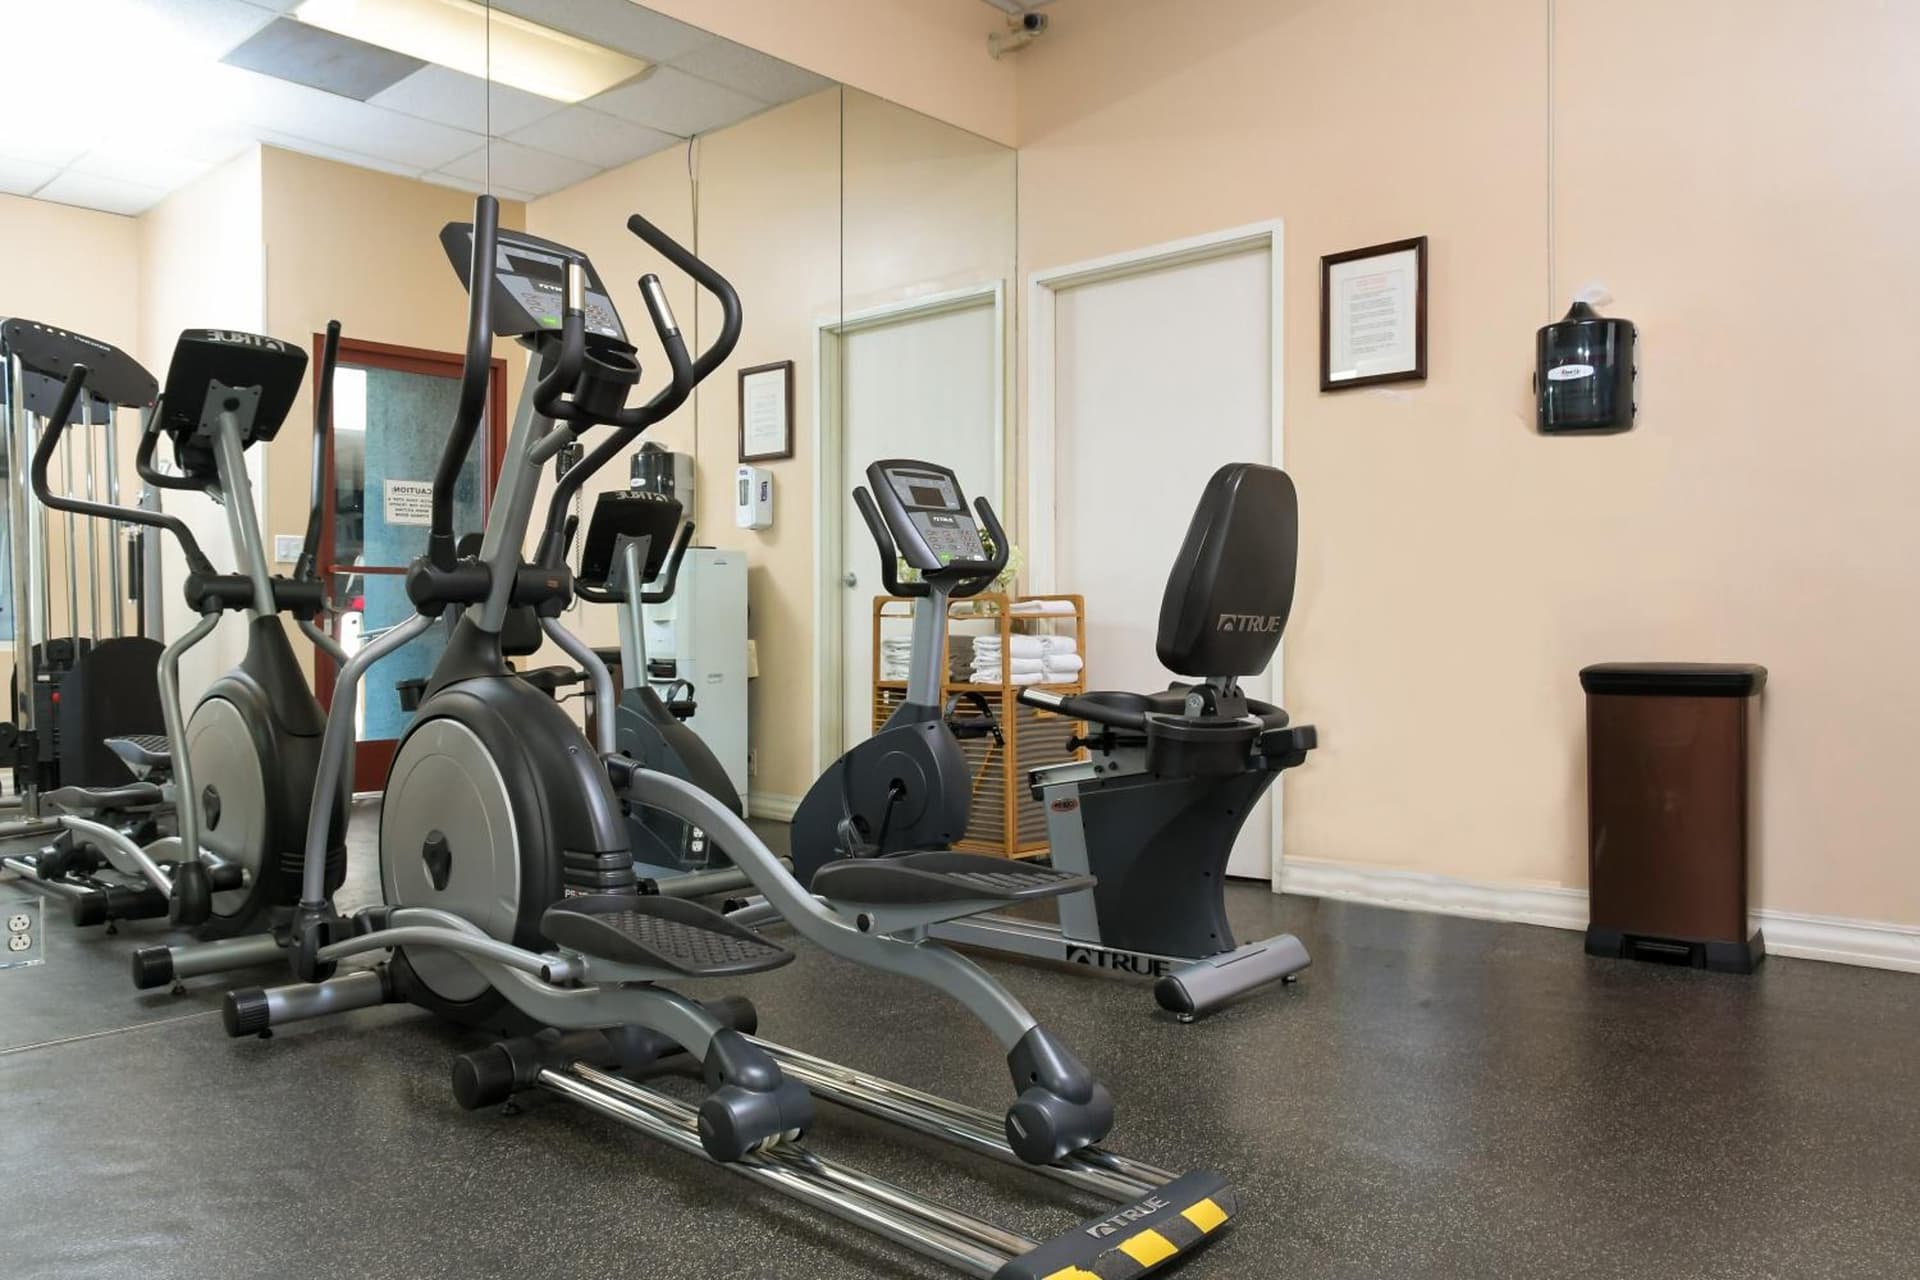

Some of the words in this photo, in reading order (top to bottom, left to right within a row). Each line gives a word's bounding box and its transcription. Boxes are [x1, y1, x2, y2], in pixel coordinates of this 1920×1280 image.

[1237, 614, 1281, 632] TRUE
[1093, 949, 1171, 978] TRUE
[1106, 1195, 1171, 1227] TRUE
